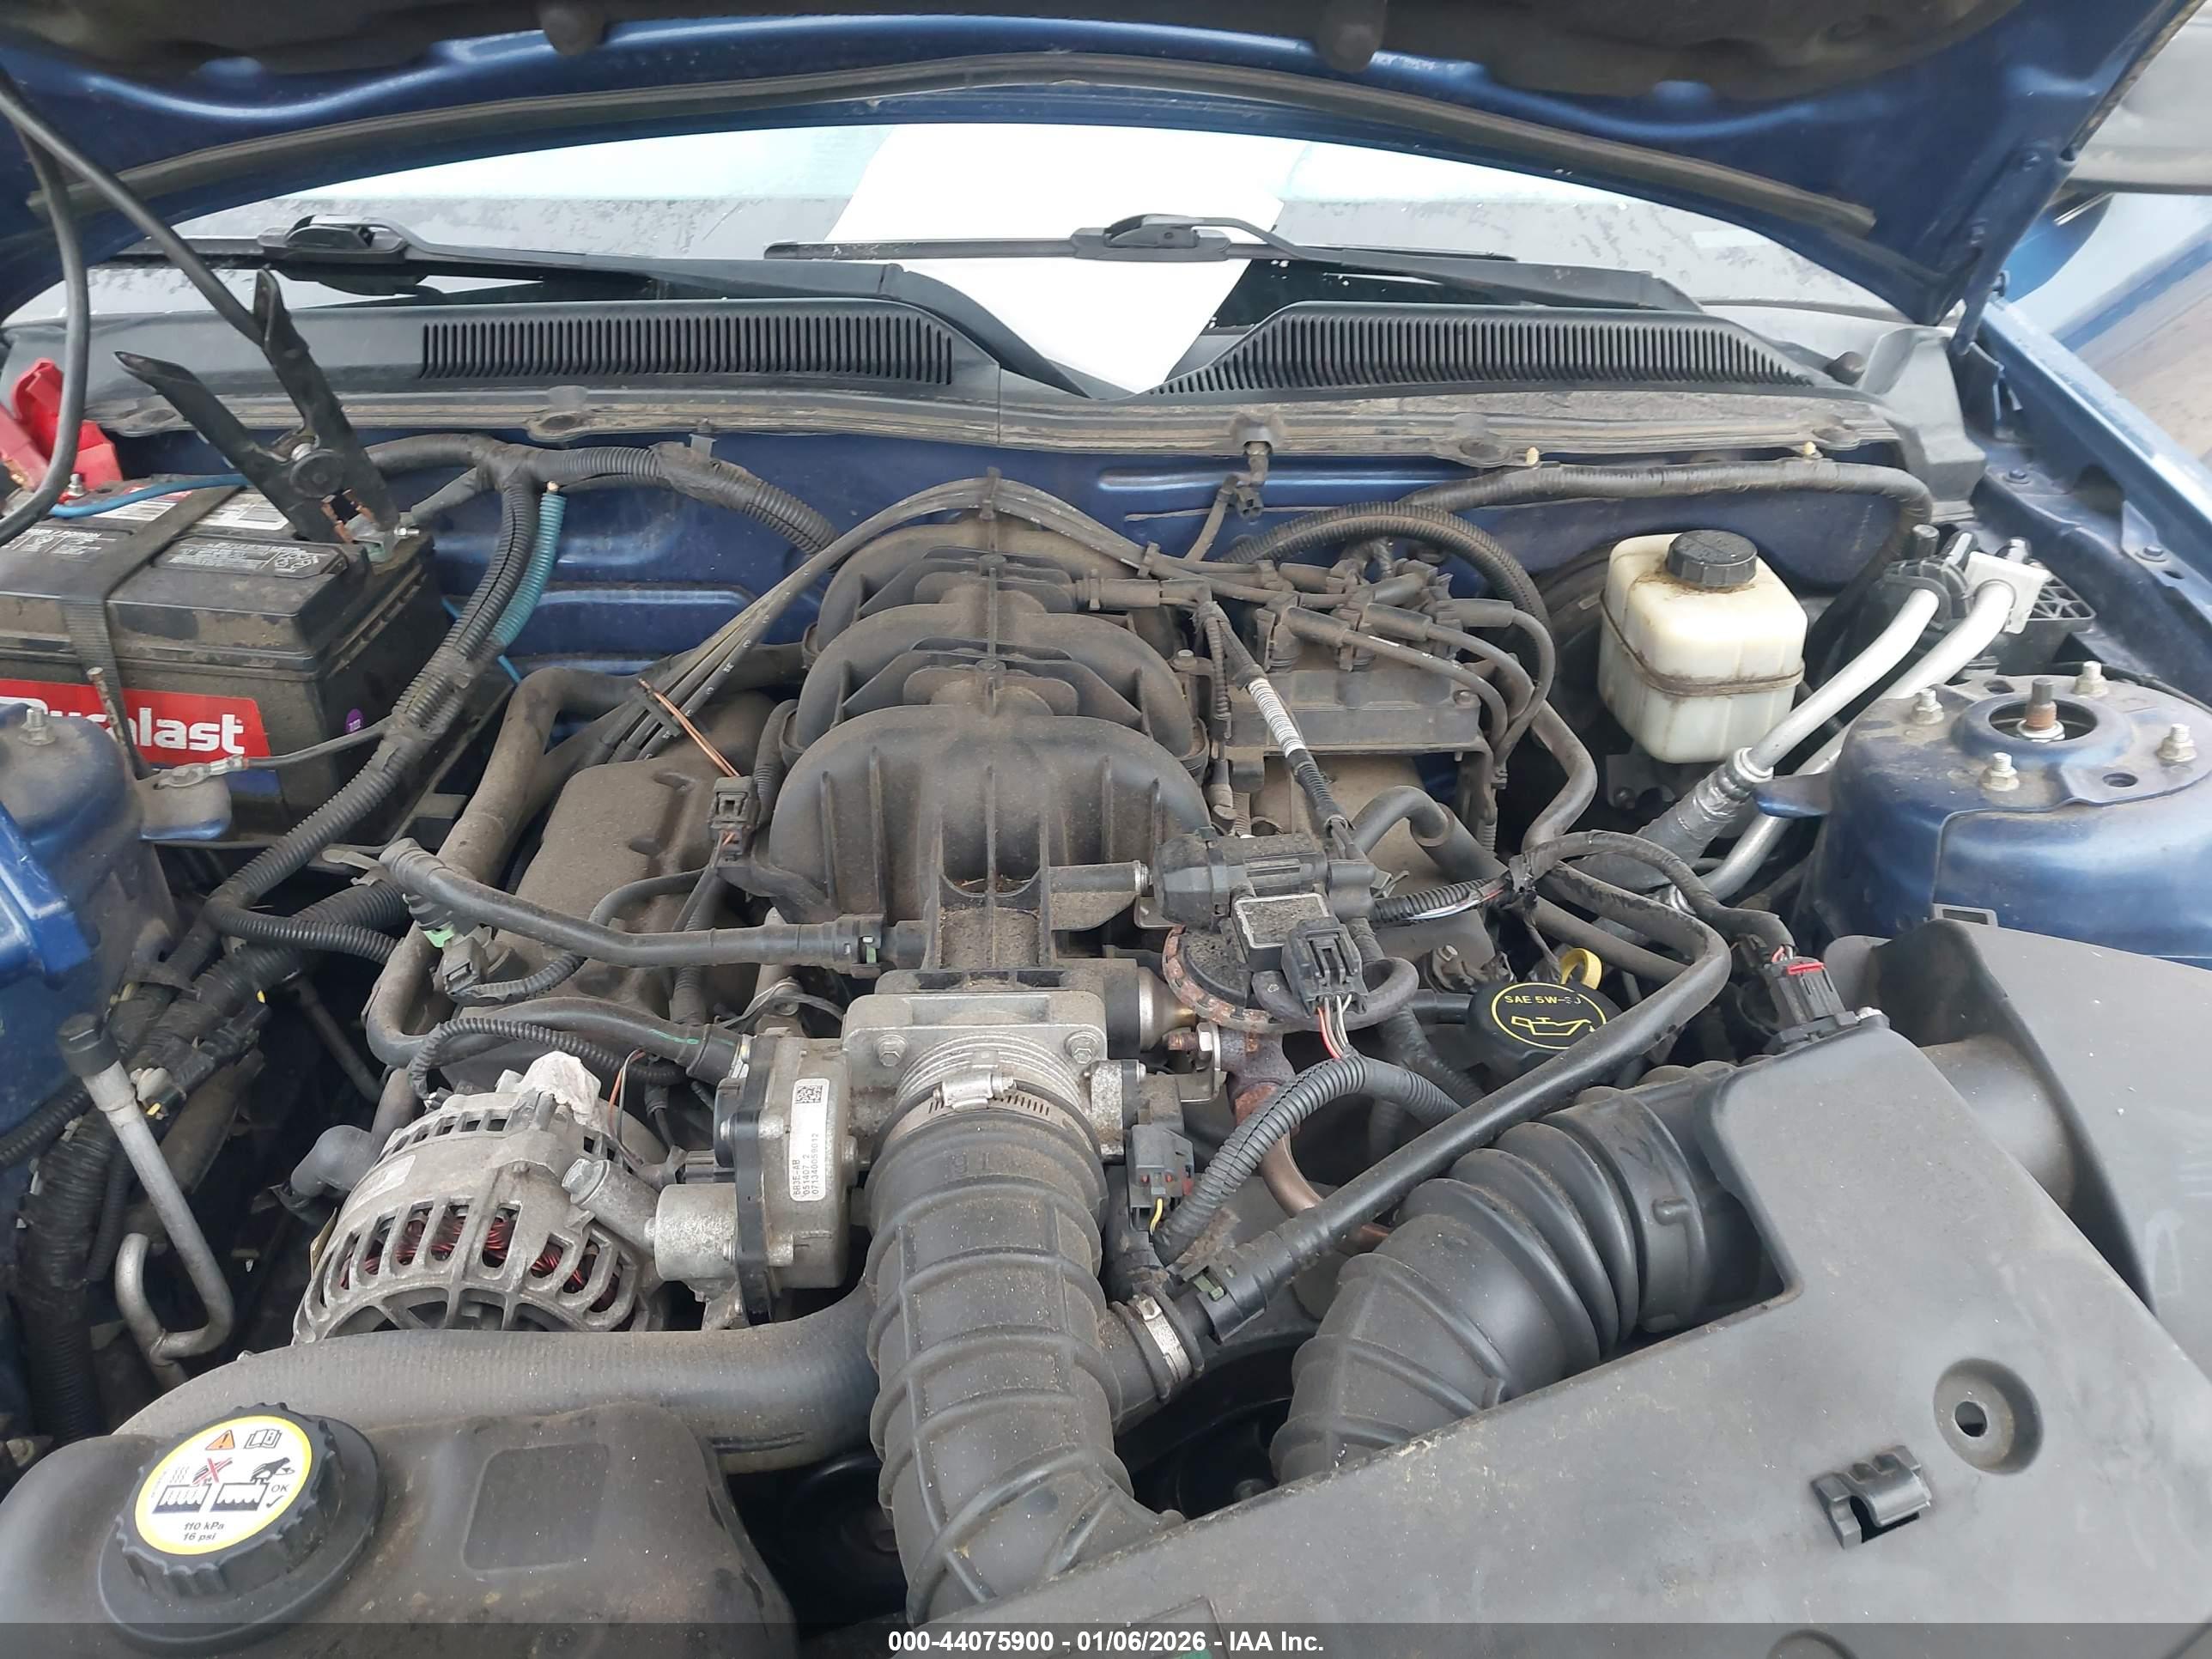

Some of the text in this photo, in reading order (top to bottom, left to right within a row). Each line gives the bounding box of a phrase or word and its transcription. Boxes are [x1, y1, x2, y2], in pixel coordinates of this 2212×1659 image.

[0, 696, 246, 755] last
[1504, 995, 1533, 1004] SAE
[271, 1484, 289, 1492] OK
[184, 1521, 225, 1531] 110 kPa
[183, 1532, 216, 1542] 16 psi
